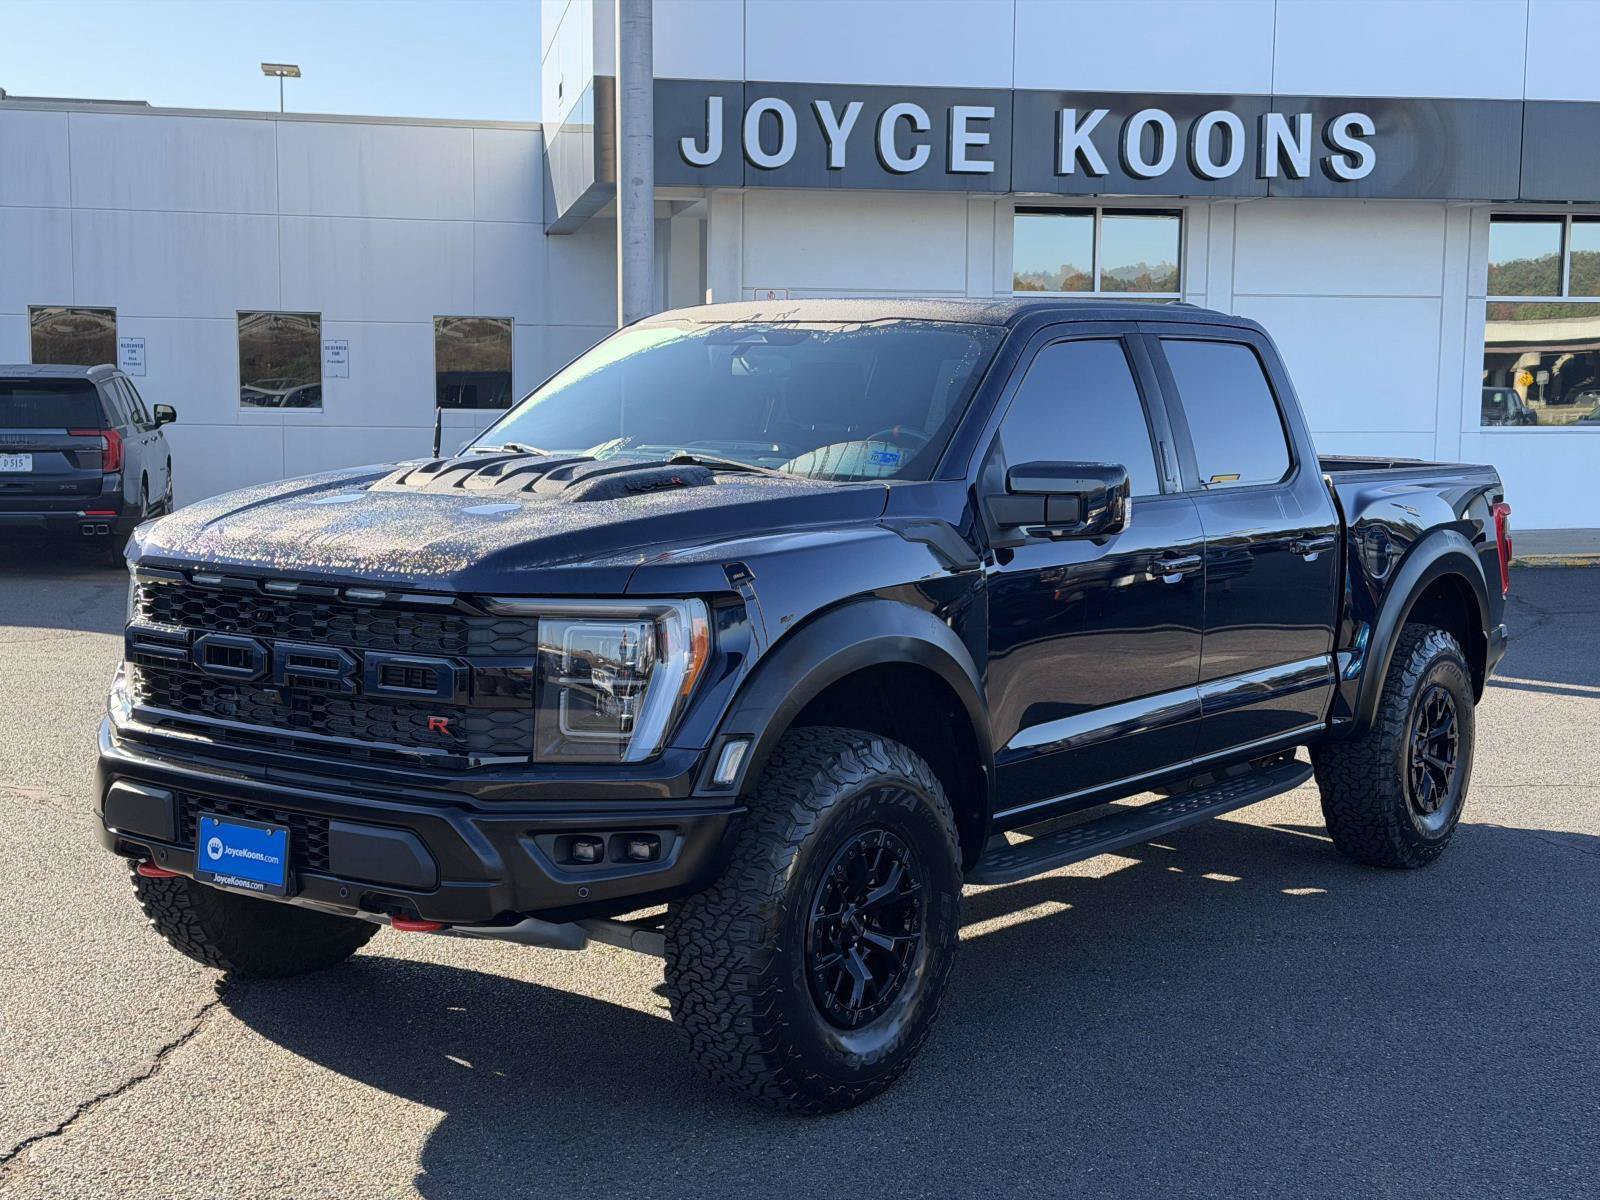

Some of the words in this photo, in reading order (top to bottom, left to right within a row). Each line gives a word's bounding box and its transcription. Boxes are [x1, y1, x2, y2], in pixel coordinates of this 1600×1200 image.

[680, 95, 997, 175] JOYCE
[1056, 107, 1379, 184] KOONS
[126, 619, 472, 706] FORD
[427, 715, 449, 735] R
[223, 844, 279, 865] JoyceKoons.com
[213, 873, 264, 891] JoyceKoons.com
